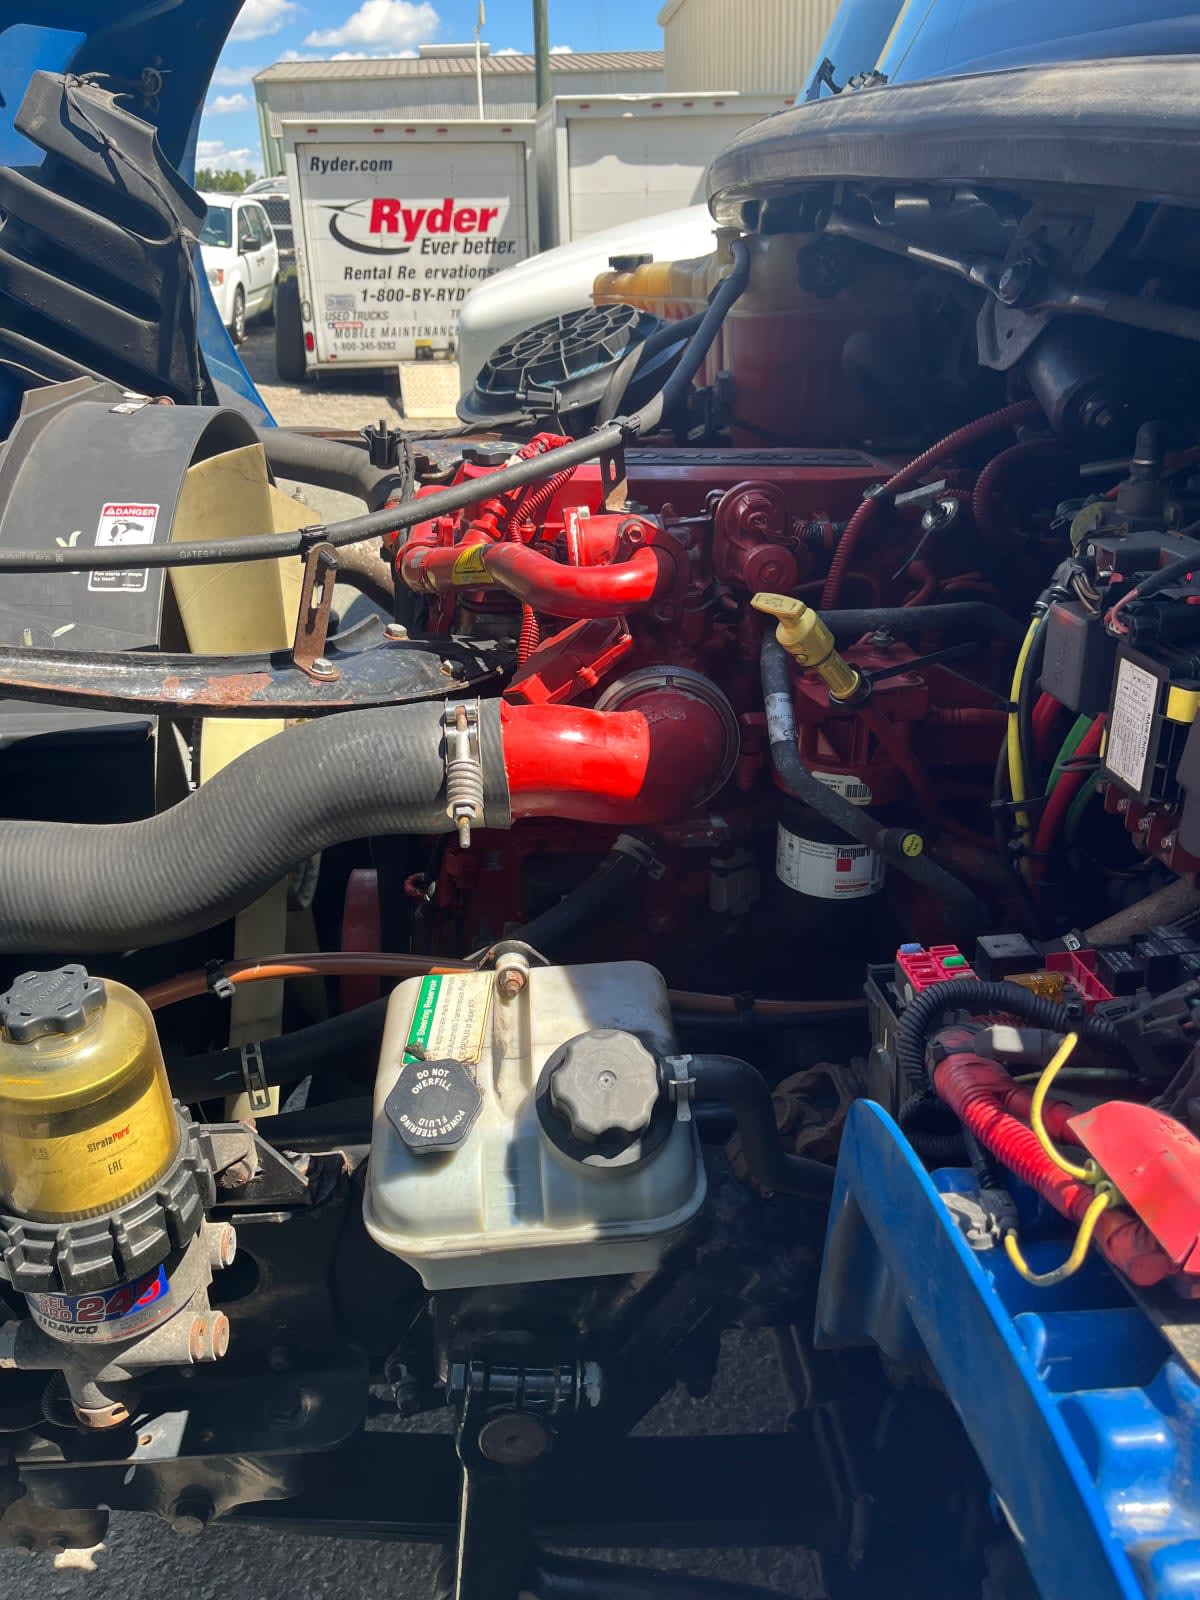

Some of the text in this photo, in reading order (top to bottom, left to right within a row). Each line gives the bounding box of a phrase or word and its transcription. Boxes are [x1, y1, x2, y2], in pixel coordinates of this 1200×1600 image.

[310, 157, 393, 174] Ryder.com
[369, 198, 499, 242] Ryder
[421, 237, 516, 255] Ever better.
[344, 265, 391, 280] Rental
[325, 311, 349, 321] USED
[352, 310, 389, 321] TRUCKS
[335, 327, 376, 339] MOBILE
[115, 508, 155, 516] DANGER
[416, 1068, 450, 1080] DO NOT
[411, 1077, 452, 1094] OVERFILL
[400, 1109, 466, 1138] POWER STEERING
[418, 1115, 448, 1127] FLUID
[48, 1321, 98, 1334] DAVCO
